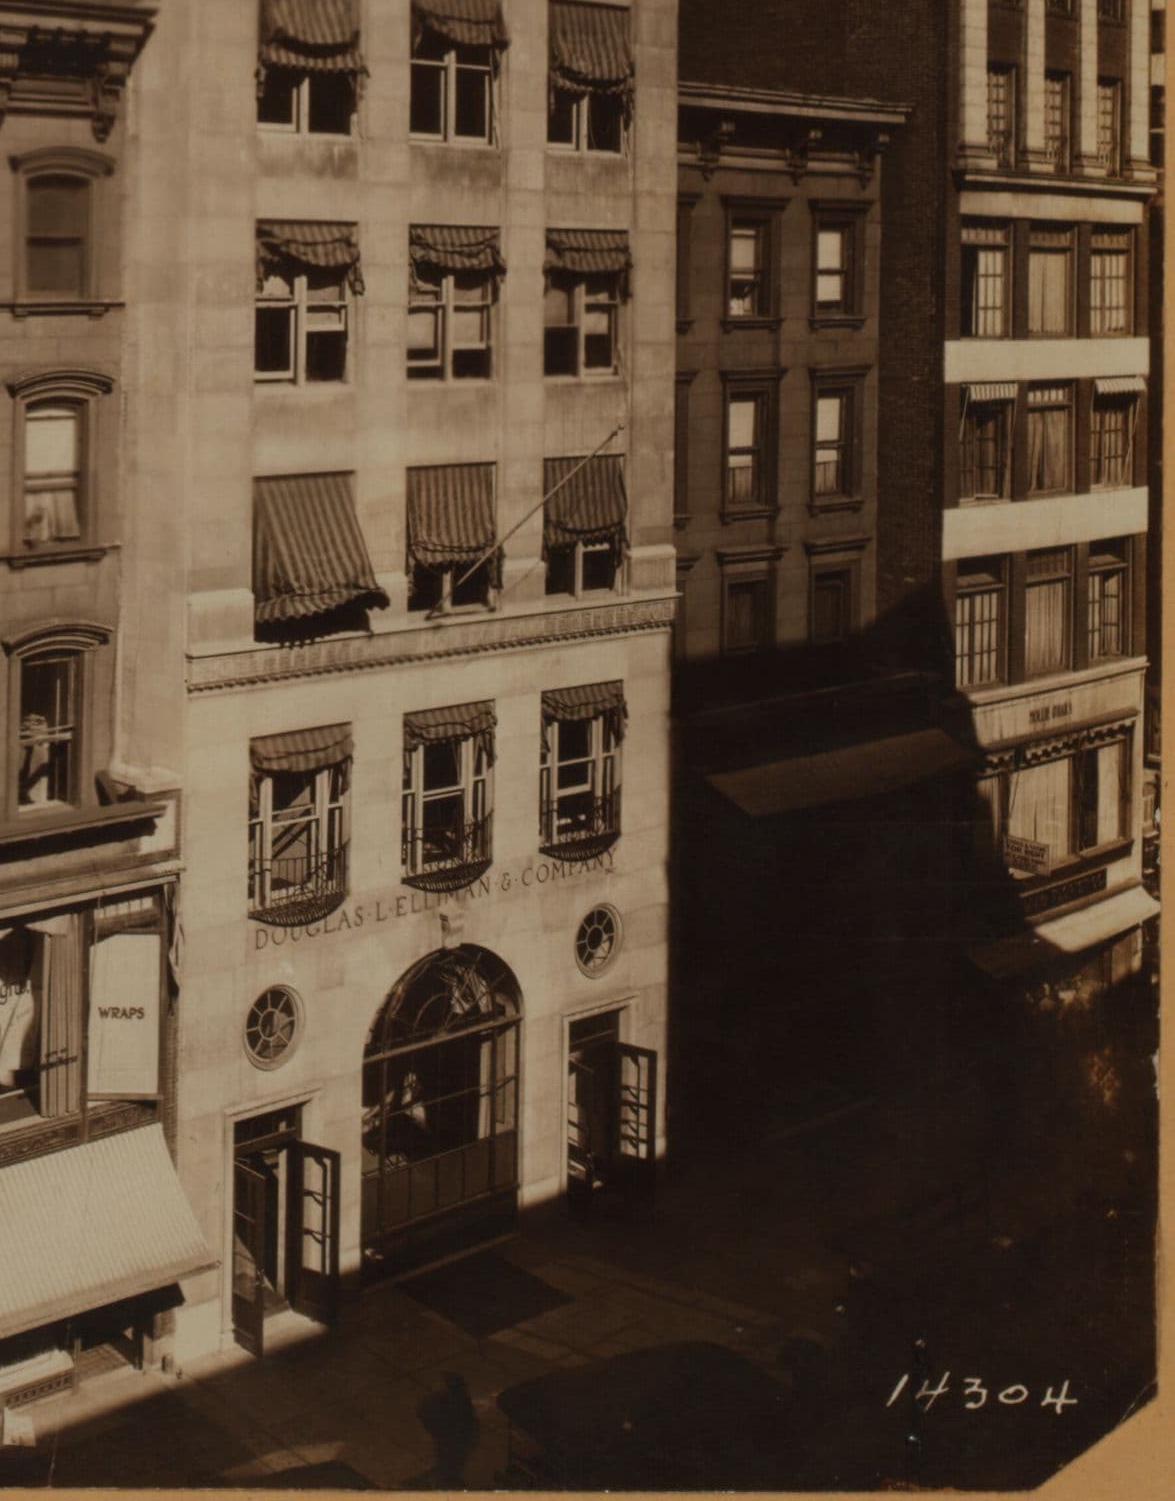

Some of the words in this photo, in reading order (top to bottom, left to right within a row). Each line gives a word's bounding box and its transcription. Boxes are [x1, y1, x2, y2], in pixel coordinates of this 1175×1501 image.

[255, 905, 364, 951] DOUGLAS
[375, 900, 388, 922] L
[395, 876, 491, 918] ELLIMAN
[500, 871, 512, 892] &
[521, 846, 617, 887] COMPANY
[97, 1005, 145, 1020] WRAPS
